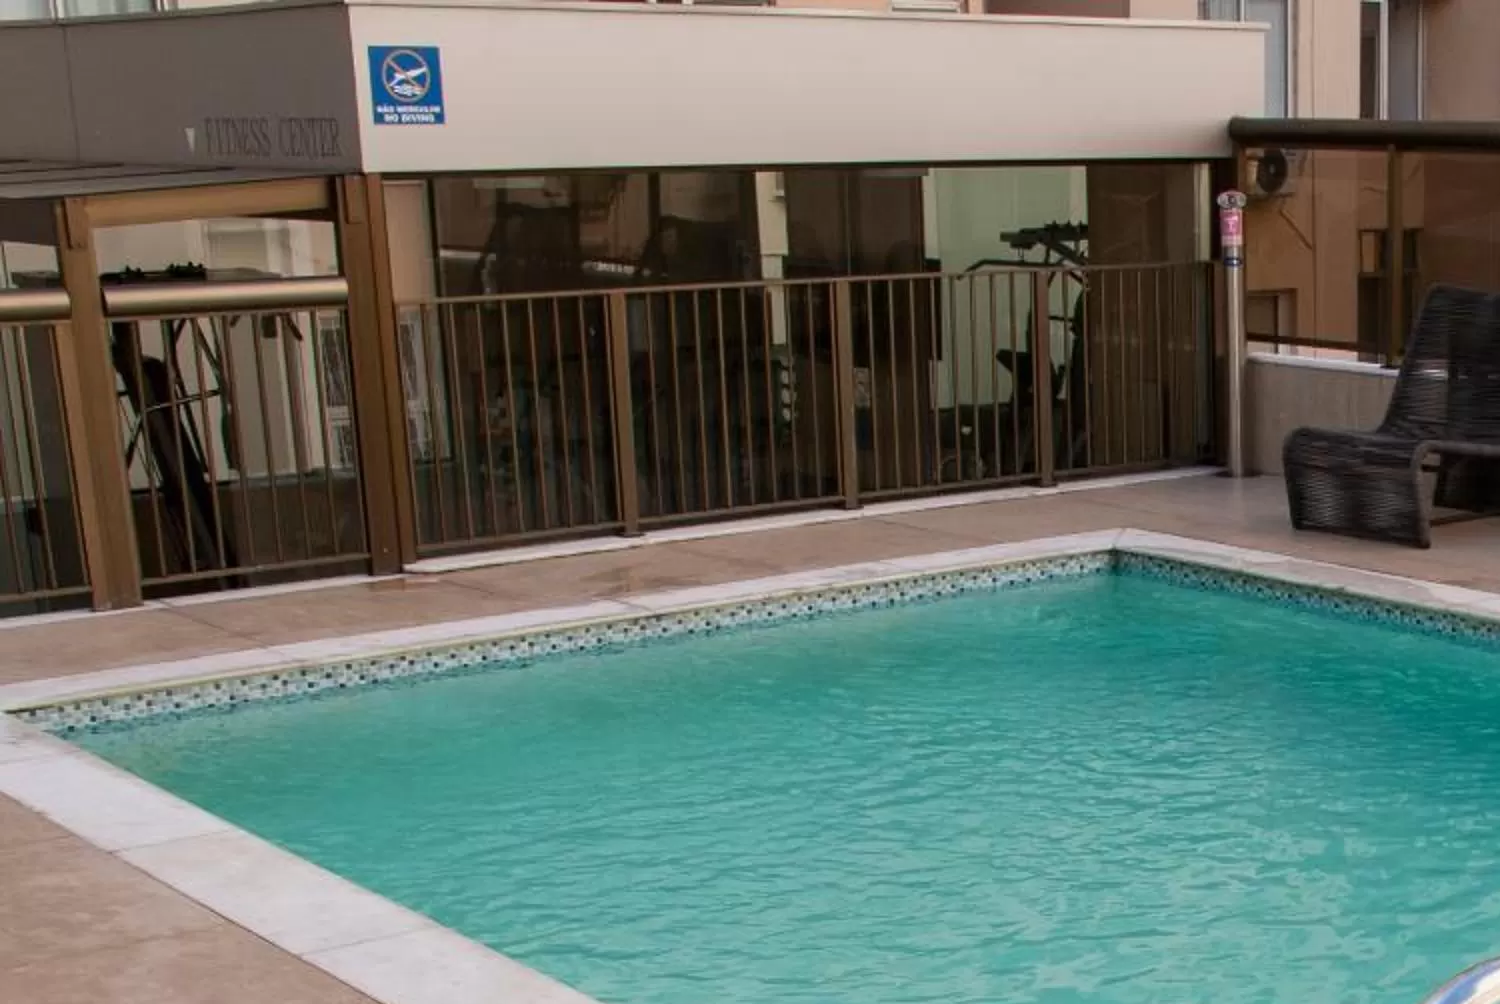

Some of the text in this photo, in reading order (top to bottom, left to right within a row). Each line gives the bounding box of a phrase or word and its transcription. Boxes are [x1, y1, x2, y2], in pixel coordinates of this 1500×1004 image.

[384, 114, 435, 122] NO DIVING
[204, 117, 342, 157] FITNESS CENTER
